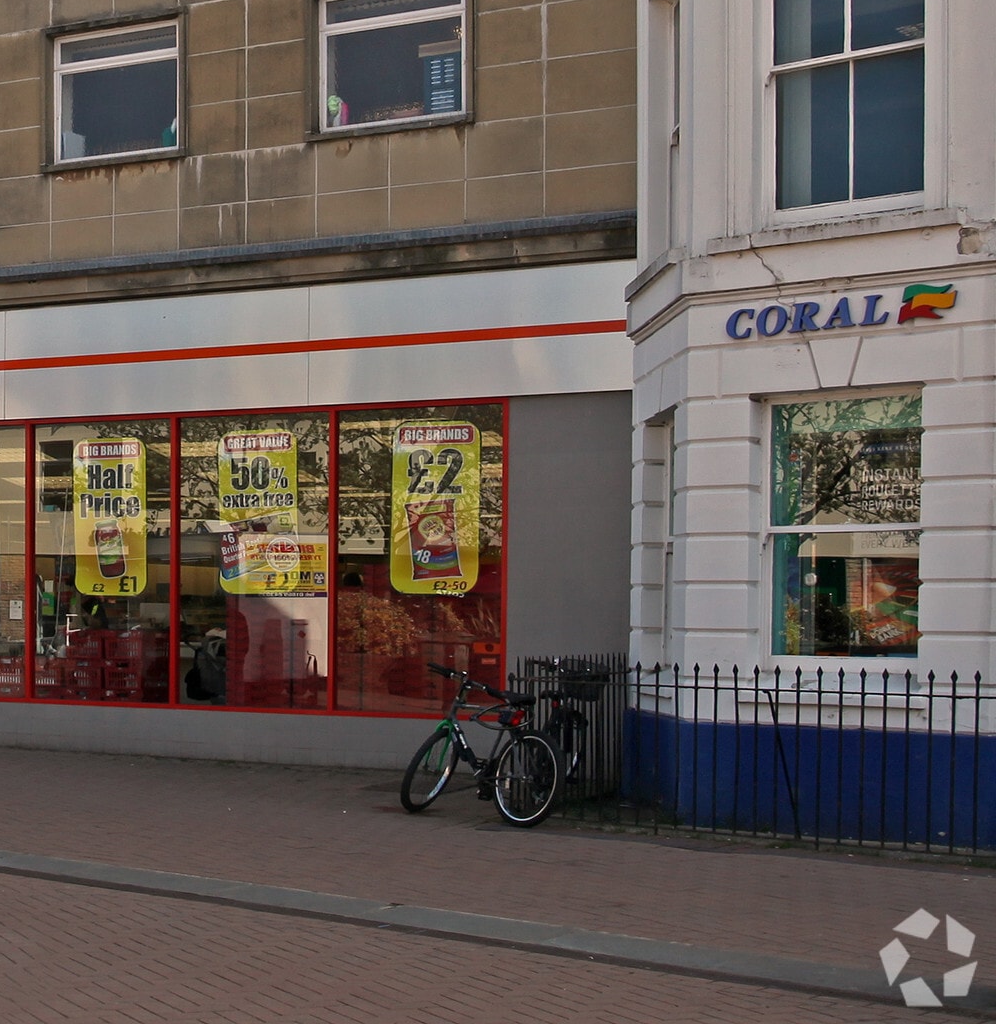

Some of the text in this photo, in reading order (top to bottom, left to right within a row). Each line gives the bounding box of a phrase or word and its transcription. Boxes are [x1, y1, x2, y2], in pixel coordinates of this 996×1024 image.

[726, 294, 889, 339] CORAL
[227, 435, 289, 449] GREAT VALUE
[404, 428, 469, 441] BIG BRANDS
[82, 444, 137, 456] BIG BRANDS
[87, 463, 134, 490] Half
[231, 456, 289, 491] 50%
[407, 448, 463, 494] £2
[80, 493, 141, 518] Price
[222, 492, 294, 509] extra free
[119, 576, 138, 593] £1
